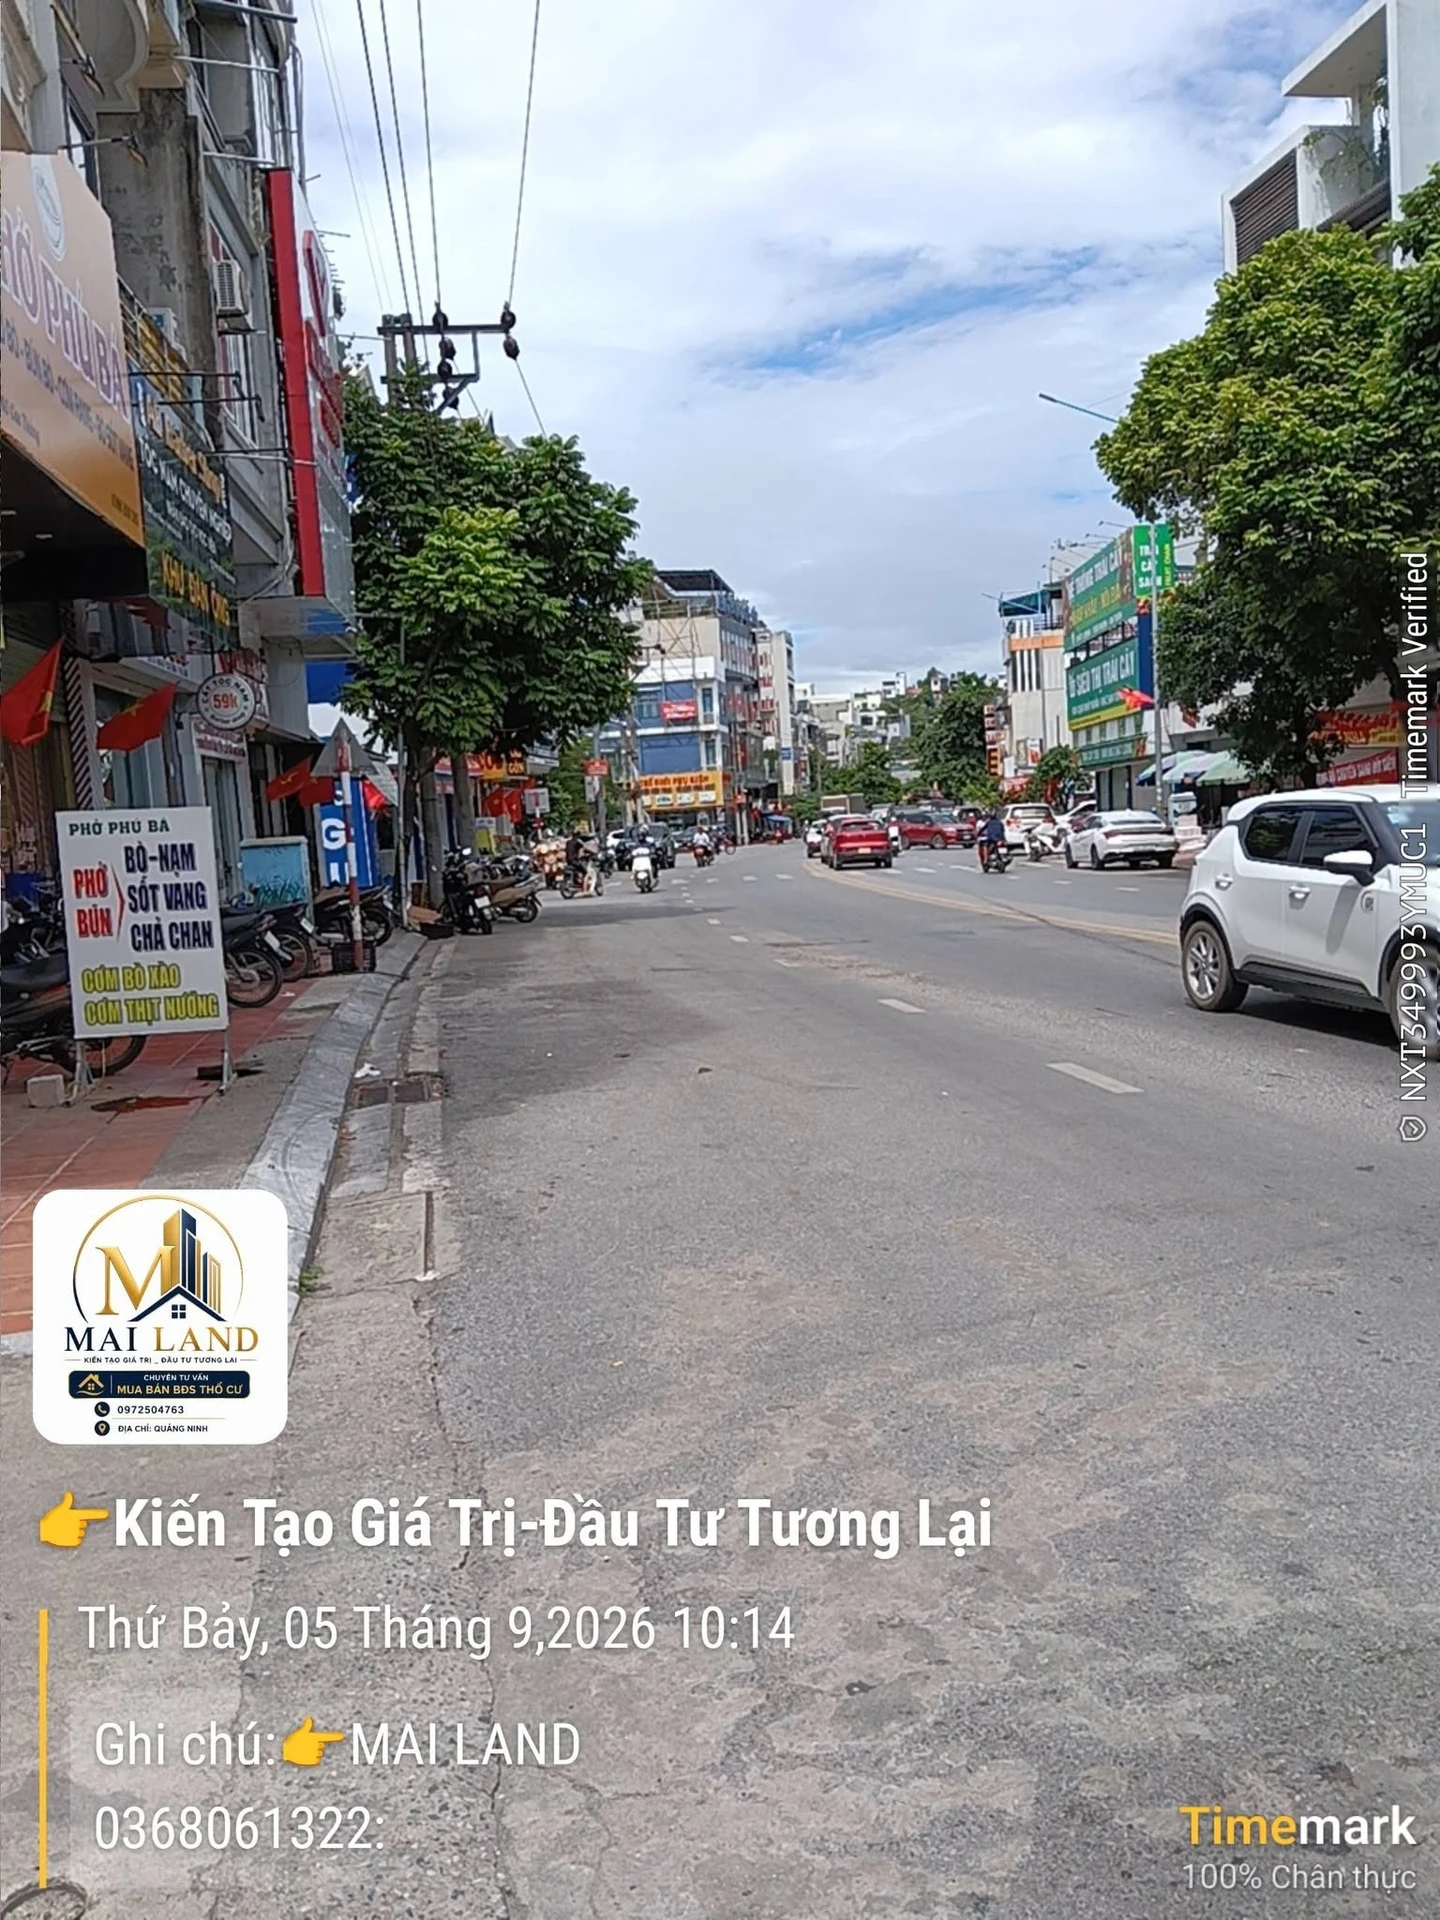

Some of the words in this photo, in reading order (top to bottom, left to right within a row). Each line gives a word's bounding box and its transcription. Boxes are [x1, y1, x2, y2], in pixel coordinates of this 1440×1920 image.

[69, 818, 102, 836] PHỞ
[108, 819, 141, 834] PHÚ
[148, 819, 170, 833] BÁ
[124, 841, 197, 878] BÒ-NẠM
[73, 861, 109, 899] PHỞ
[128, 875, 160, 914] SỐT
[164, 882, 207, 911] VANG
[76, 903, 113, 938] BÚN
[131, 917, 166, 952] CHẢ
[169, 921, 214, 949] CHAN
[82, 964, 119, 993] CƠM
[123, 961, 146, 991] BÒ
[148, 960, 181, 988] XÀO
[85, 998, 121, 1026] CƠM
[125, 999, 161, 1026] THỊT
[164, 991, 219, 1020] NƯỚNG
